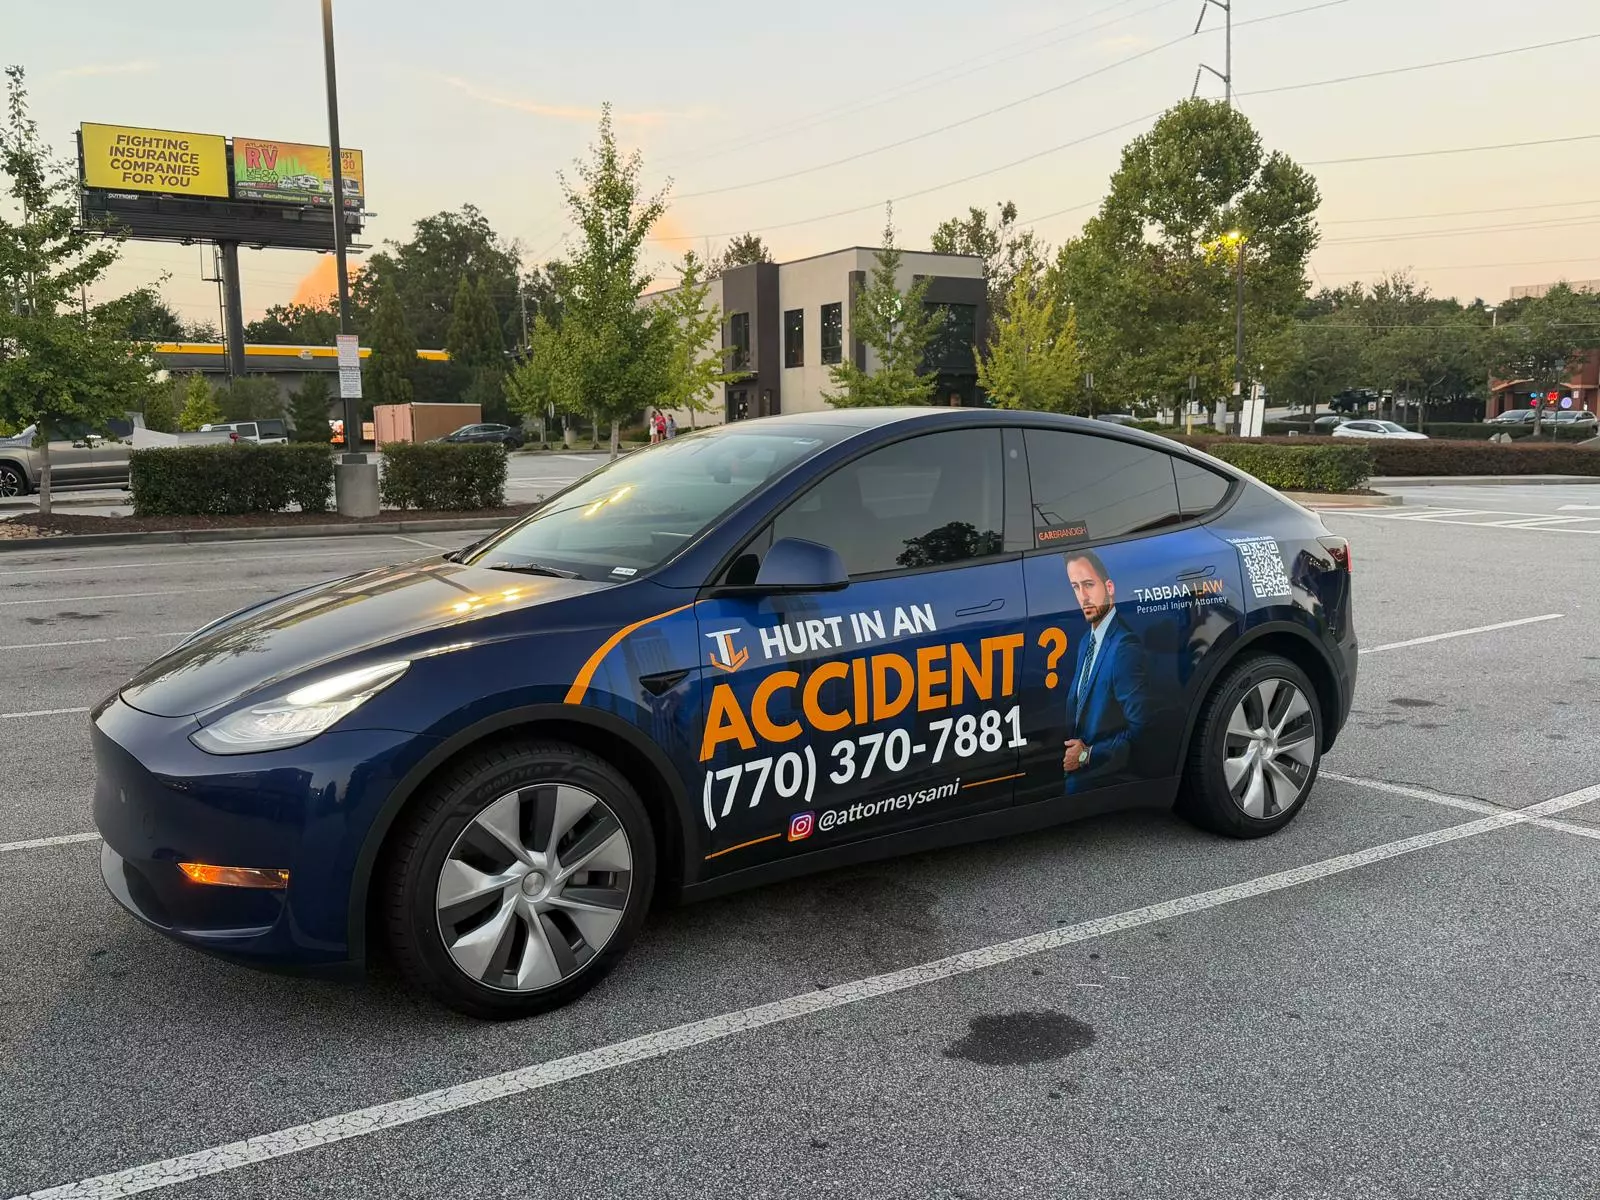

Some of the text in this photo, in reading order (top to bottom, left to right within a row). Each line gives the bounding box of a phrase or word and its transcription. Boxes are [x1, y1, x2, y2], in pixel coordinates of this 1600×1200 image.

[116, 134, 189, 151] FIGHTING
[109, 146, 199, 165] INSURANCE
[110, 158, 200, 176] COMPANIES
[245, 147, 279, 170] RV
[122, 172, 191, 187] FOR YOU
[1133, 579, 1223, 602] TABBAA LAW
[1136, 596, 1228, 614] Personal Injury Attorney
[758, 603, 937, 659] HURT IN AN
[699, 632, 1025, 762] ACCIDENT
[703, 705, 1028, 831] (770) 370-7881
[818, 777, 961, 832] @attorneysami
